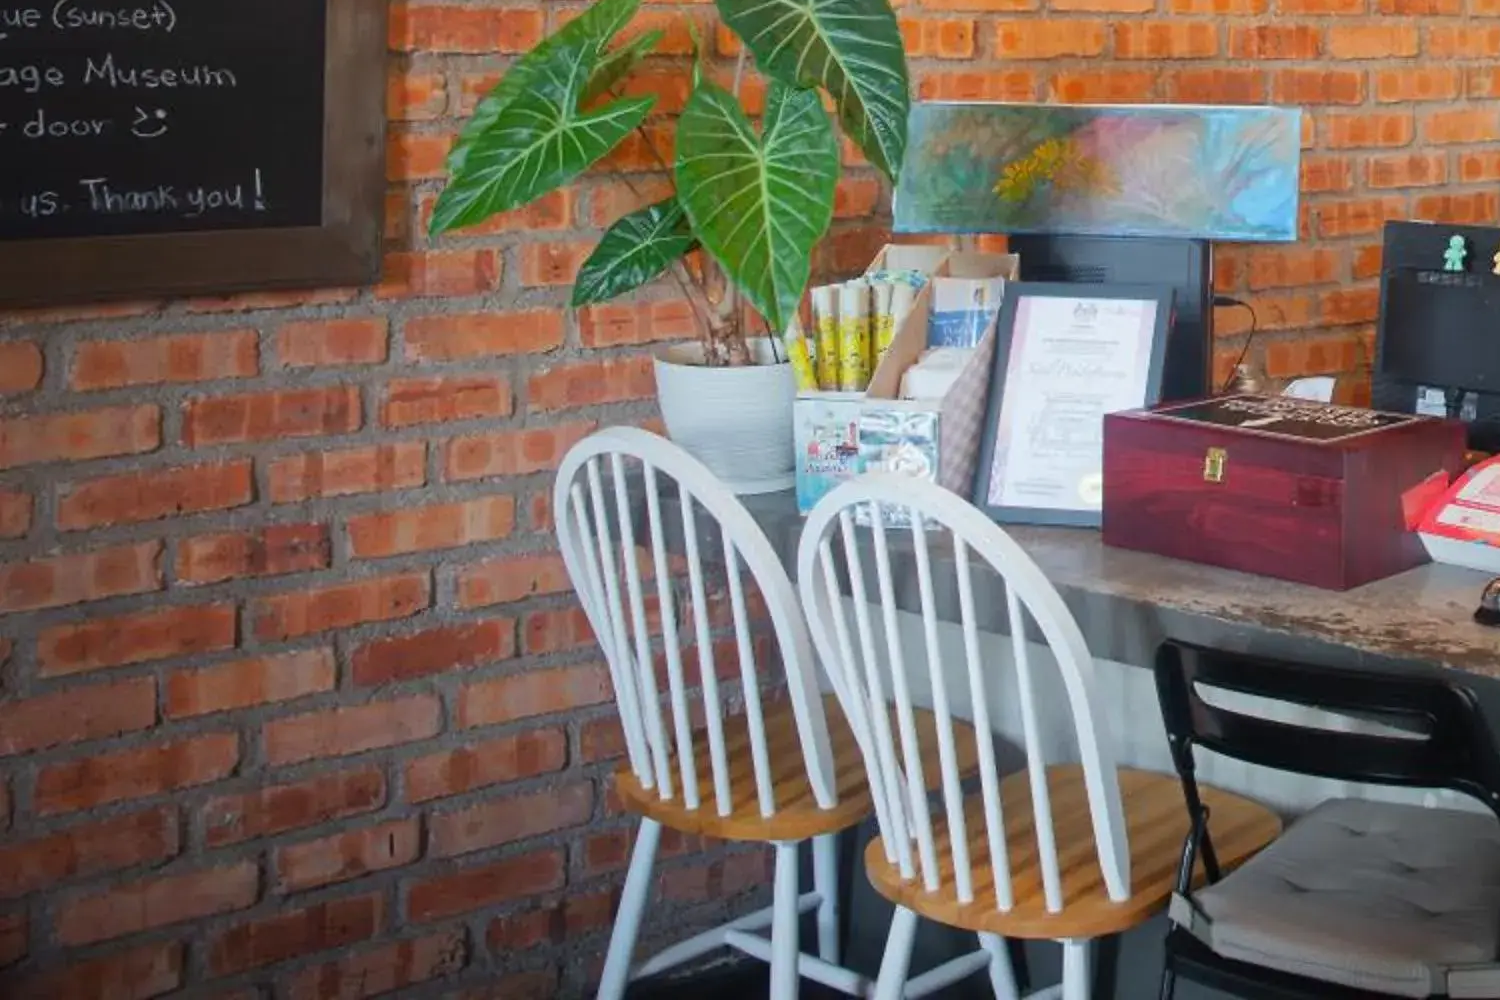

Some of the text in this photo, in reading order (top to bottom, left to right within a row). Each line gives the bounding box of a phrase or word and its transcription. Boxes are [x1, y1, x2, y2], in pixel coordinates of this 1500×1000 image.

[83, 52, 237, 88] Museum
[23, 108, 110, 138] door
[79, 177, 178, 212] Thank
